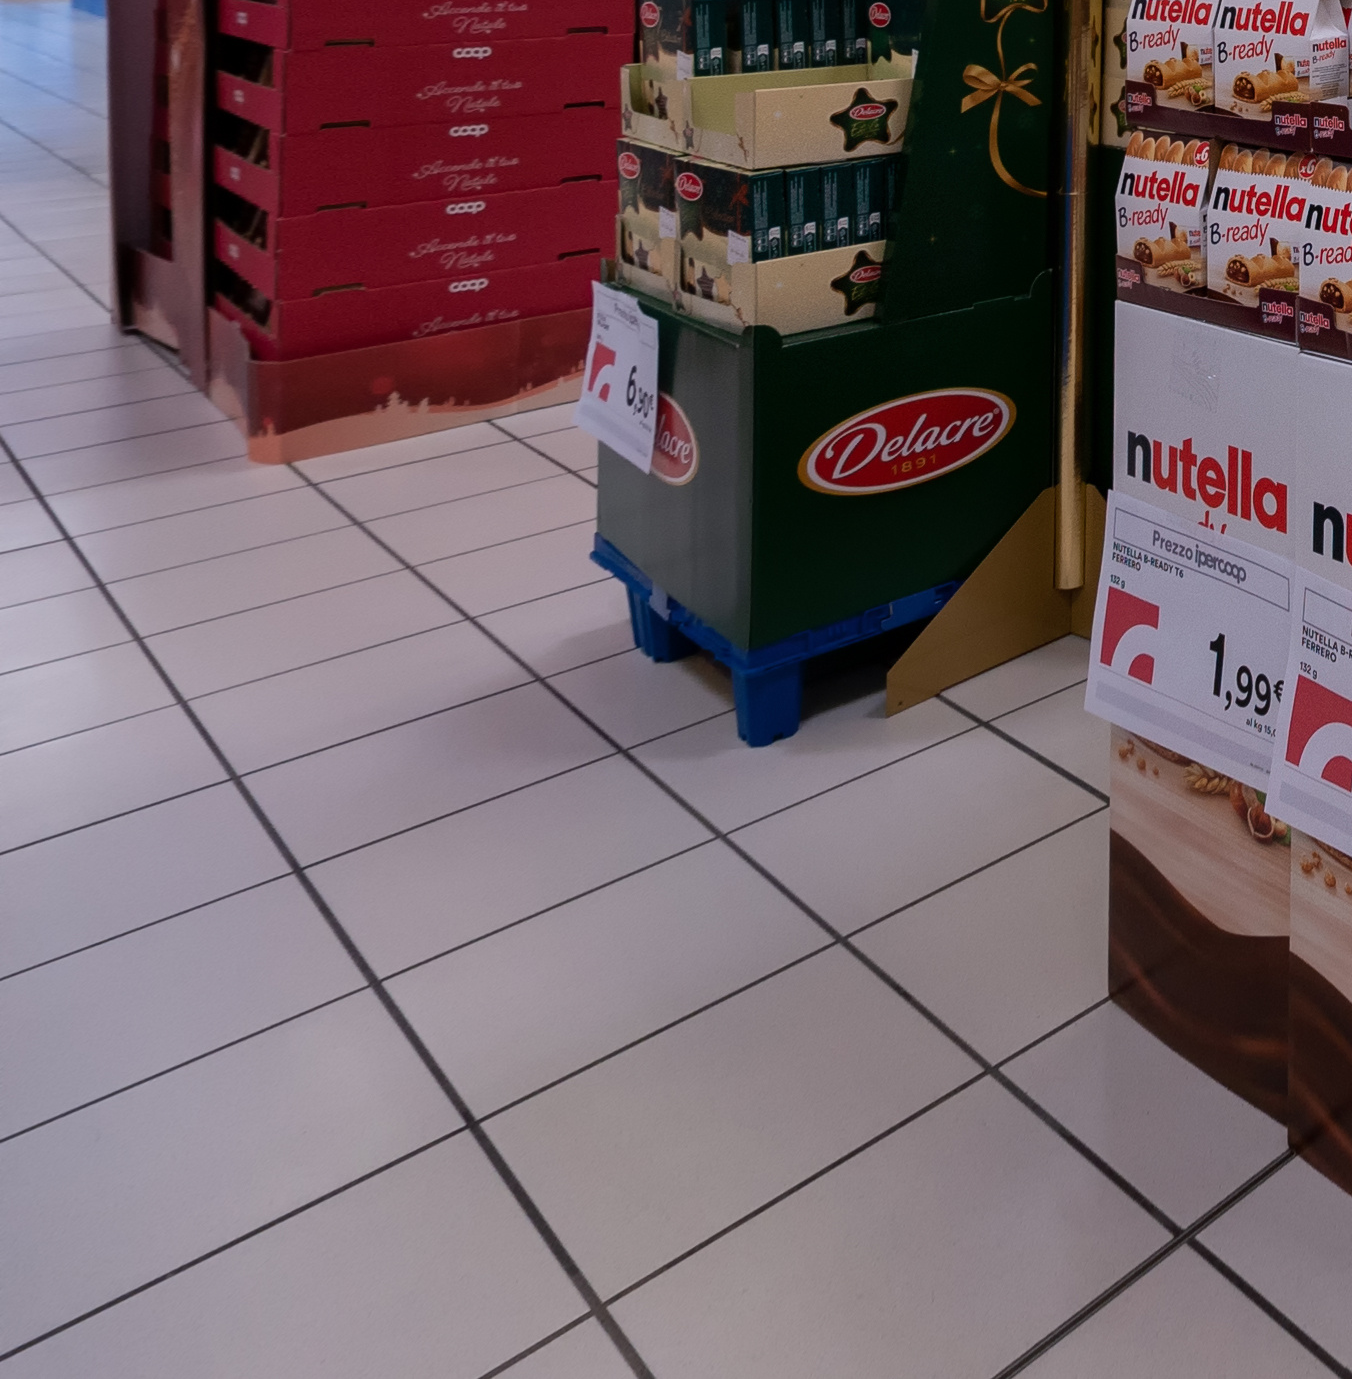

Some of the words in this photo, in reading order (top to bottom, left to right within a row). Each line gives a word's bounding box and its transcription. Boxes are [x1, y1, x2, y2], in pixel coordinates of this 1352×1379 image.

[825, 412, 994, 481] Delacre
[891, 453, 937, 477] 1891
[1127, 430, 1288, 534] nutella
[1301, 625, 1338, 654] NUTELLA
[1301, 637, 1337, 664] FERRERO
[1299, 661, 1312, 677] 132
[1312, 667, 1318, 679] g
